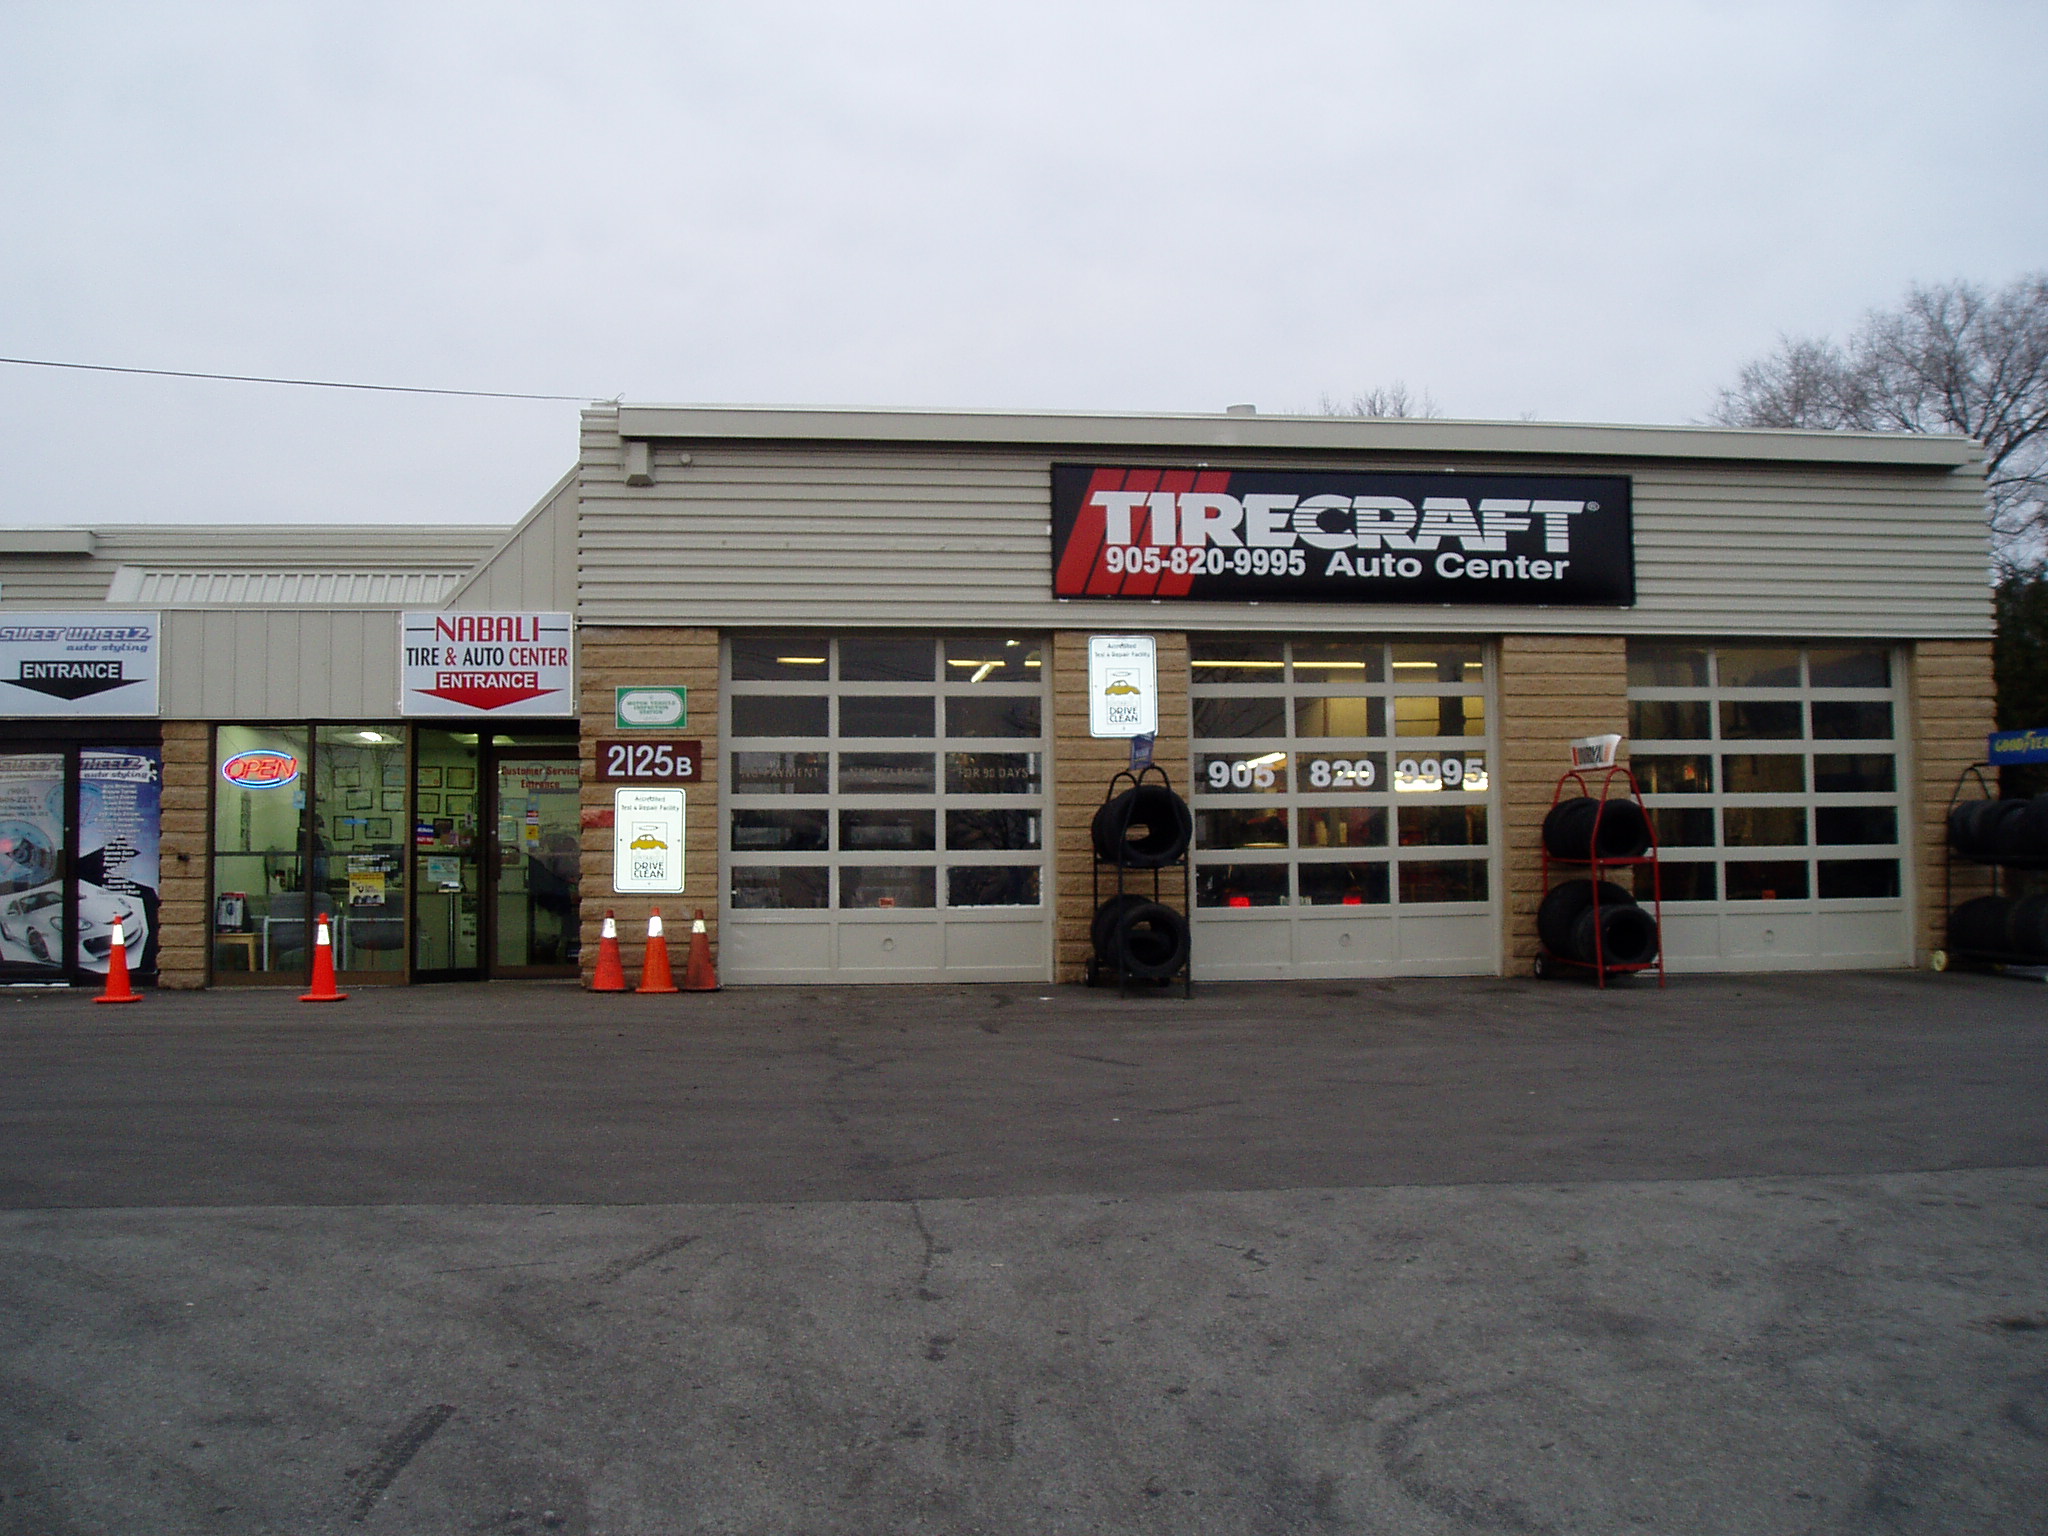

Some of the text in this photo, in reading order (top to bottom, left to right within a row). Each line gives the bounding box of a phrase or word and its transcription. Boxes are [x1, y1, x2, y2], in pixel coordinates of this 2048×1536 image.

[1090, 490, 1586, 553] TIRECRAFT
[1106, 546, 1307, 576] 905-820-9995
[1325, 550, 1570, 580] Auto Center
[0, 627, 152, 642] SWEET WHEELZ
[435, 616, 540, 642] NABALI
[66, 643, 149, 653] auto styling
[406, 647, 568, 666] TIRE & AUTO CENTER
[23, 663, 120, 678] ENTRANCE
[438, 673, 535, 688] ENTRANCE
[1109, 706, 1138, 715] DRIVE
[1109, 714, 1139, 722] CLEAN
[225, 757, 298, 779] OPEN
[998, 768, 1030, 778] DAYS
[1208, 758, 1484, 788] 905 820 9995
[634, 861, 665, 871] DRIVE
[633, 870, 665, 878] CLEAN
